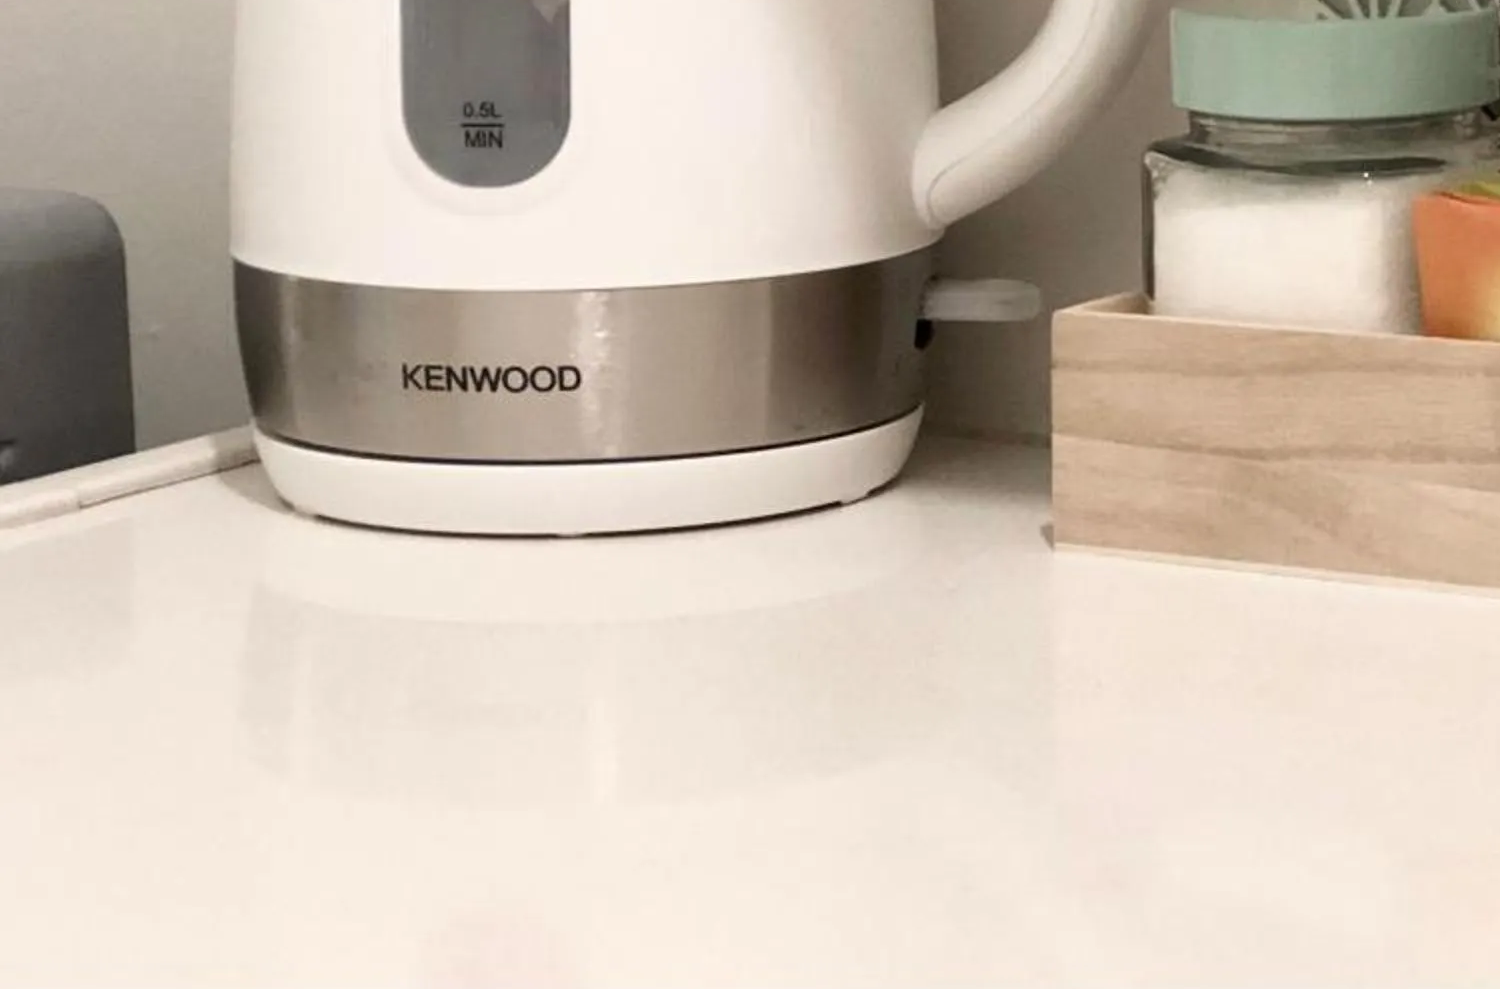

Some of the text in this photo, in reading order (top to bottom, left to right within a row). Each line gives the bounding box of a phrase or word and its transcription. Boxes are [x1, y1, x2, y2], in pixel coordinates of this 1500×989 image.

[462, 102, 501, 118] 0.5L
[463, 131, 503, 149] MIN
[401, 363, 581, 392] KENWOOD
